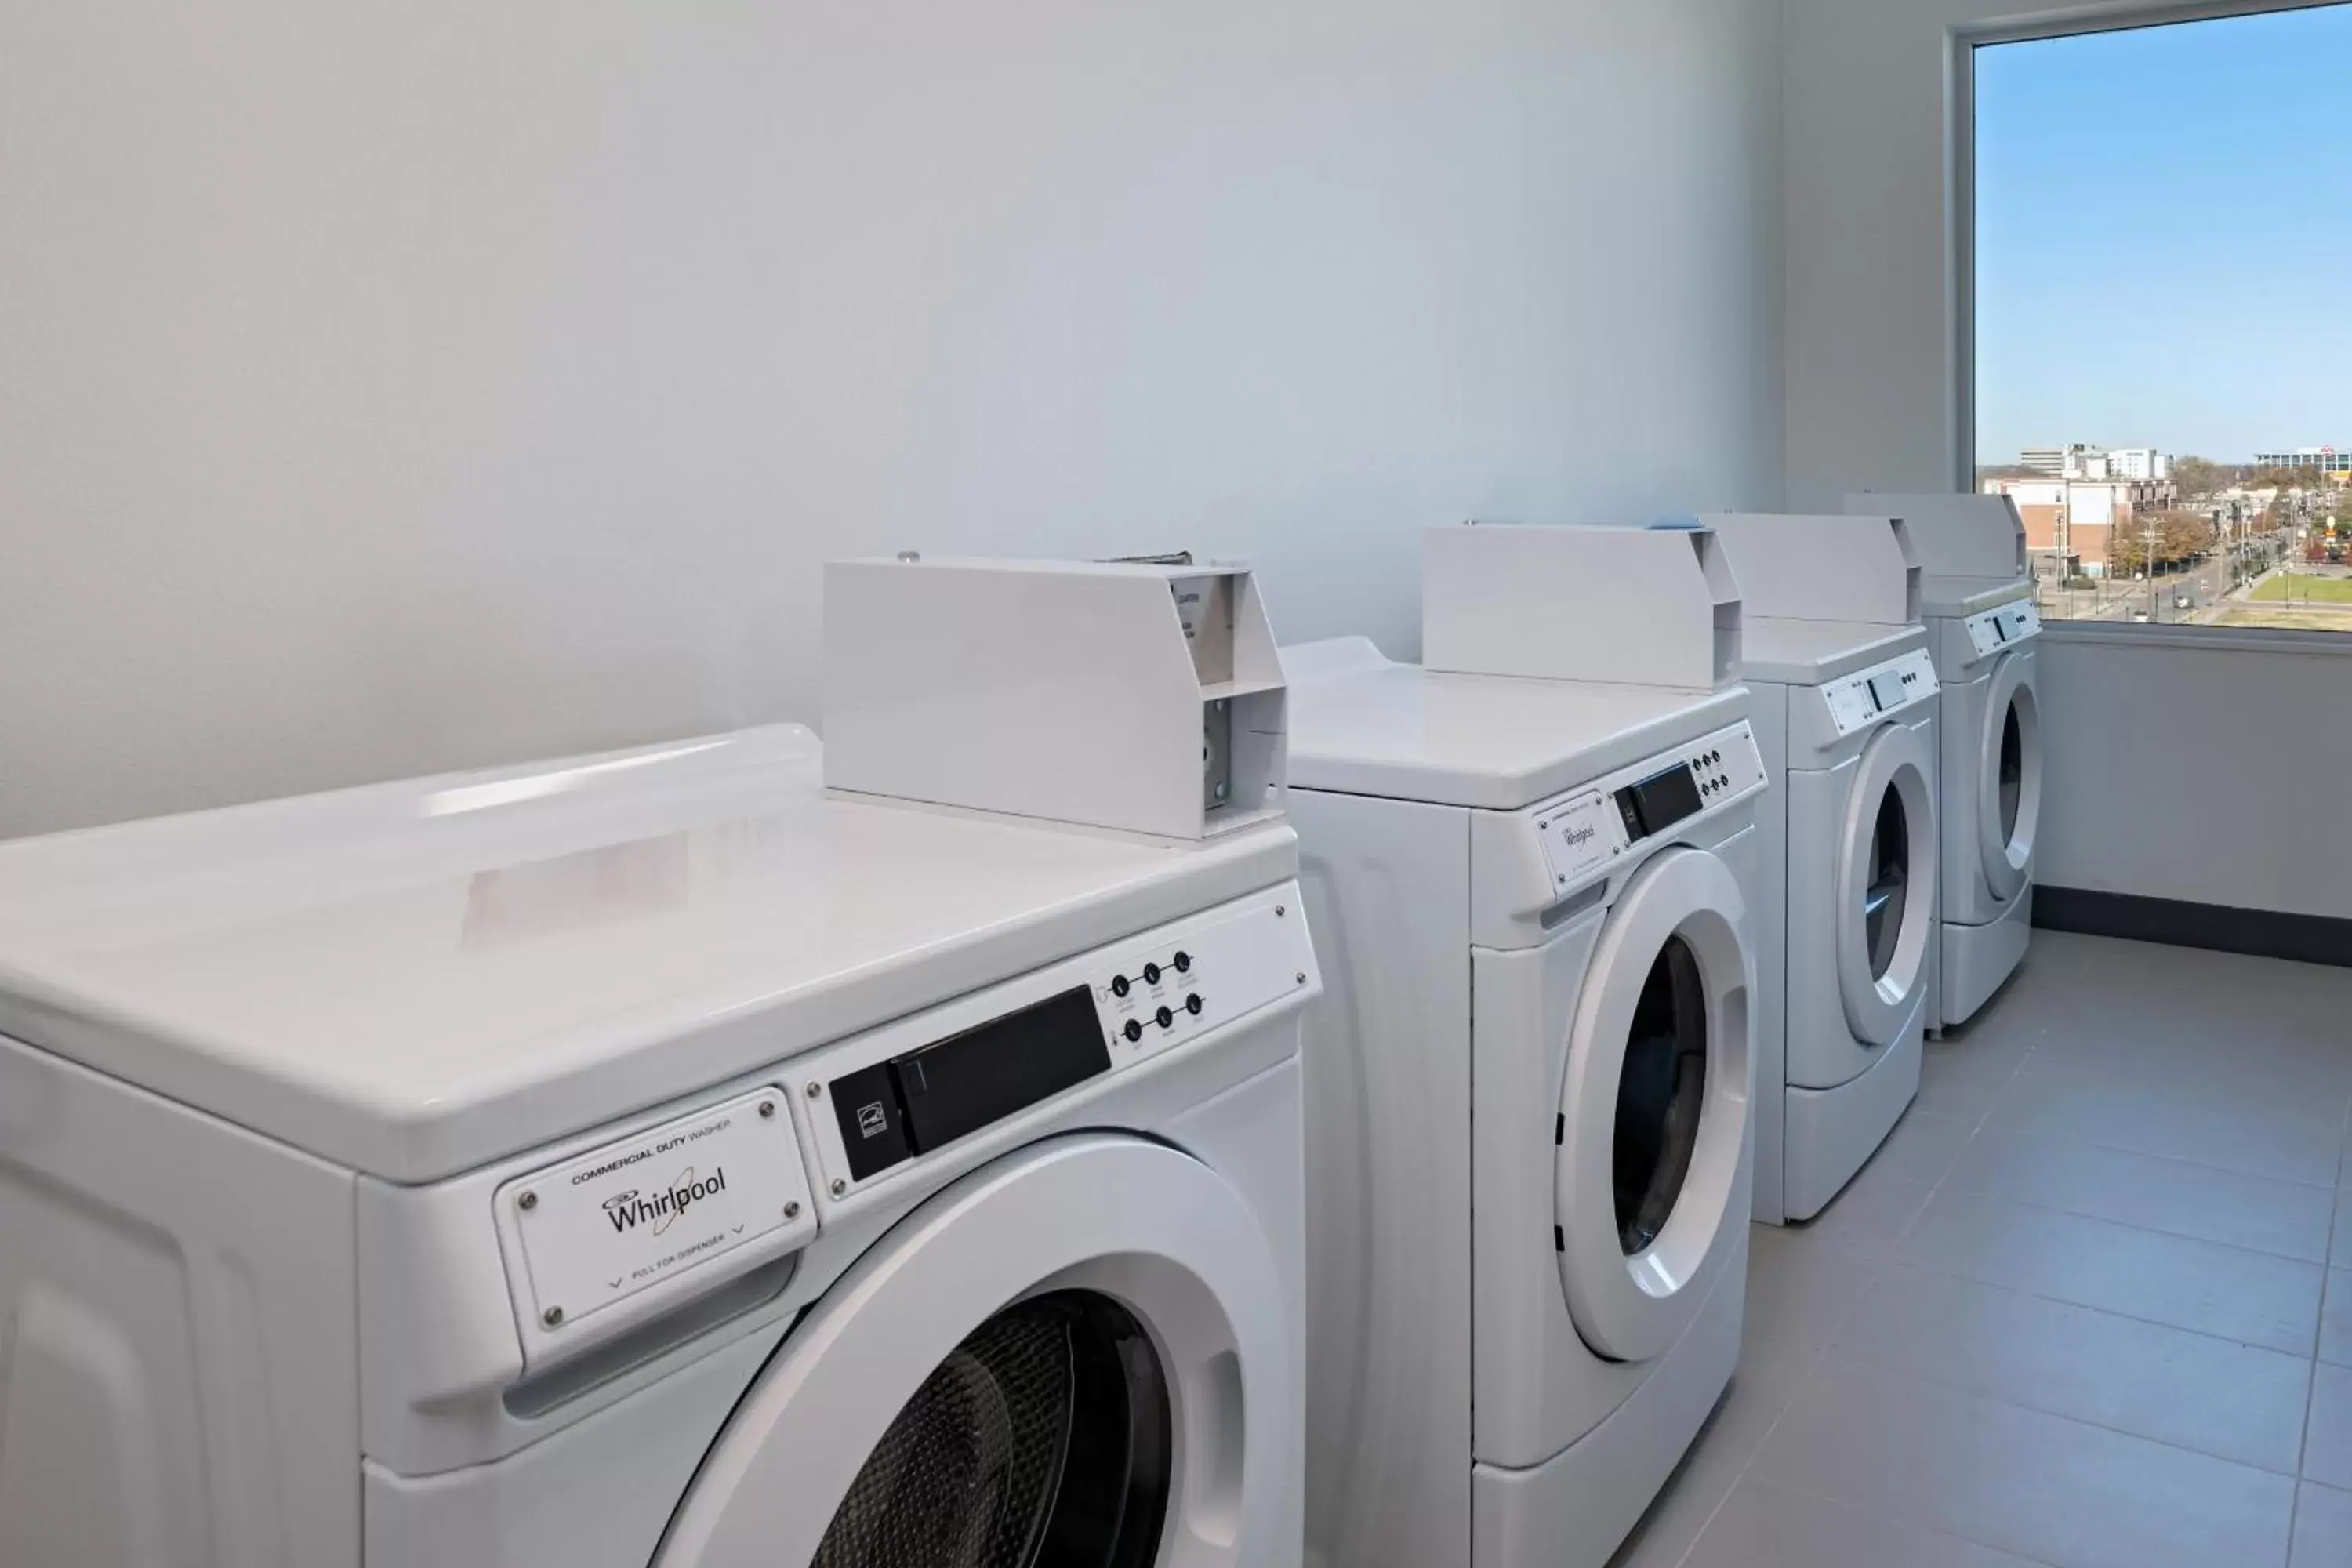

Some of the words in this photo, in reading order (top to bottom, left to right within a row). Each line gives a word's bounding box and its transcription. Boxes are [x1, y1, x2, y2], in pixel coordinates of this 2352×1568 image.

[572, 1149, 653, 1185] COMMERCIAL
[656, 1135, 686, 1153] DUTY
[688, 1118, 731, 1141] WASHER
[608, 1167, 726, 1233] Whirlpool
[631, 1265, 655, 1279] PULL
[657, 1255, 676, 1269] FOR
[677, 1233, 725, 1260] DISPENSER
